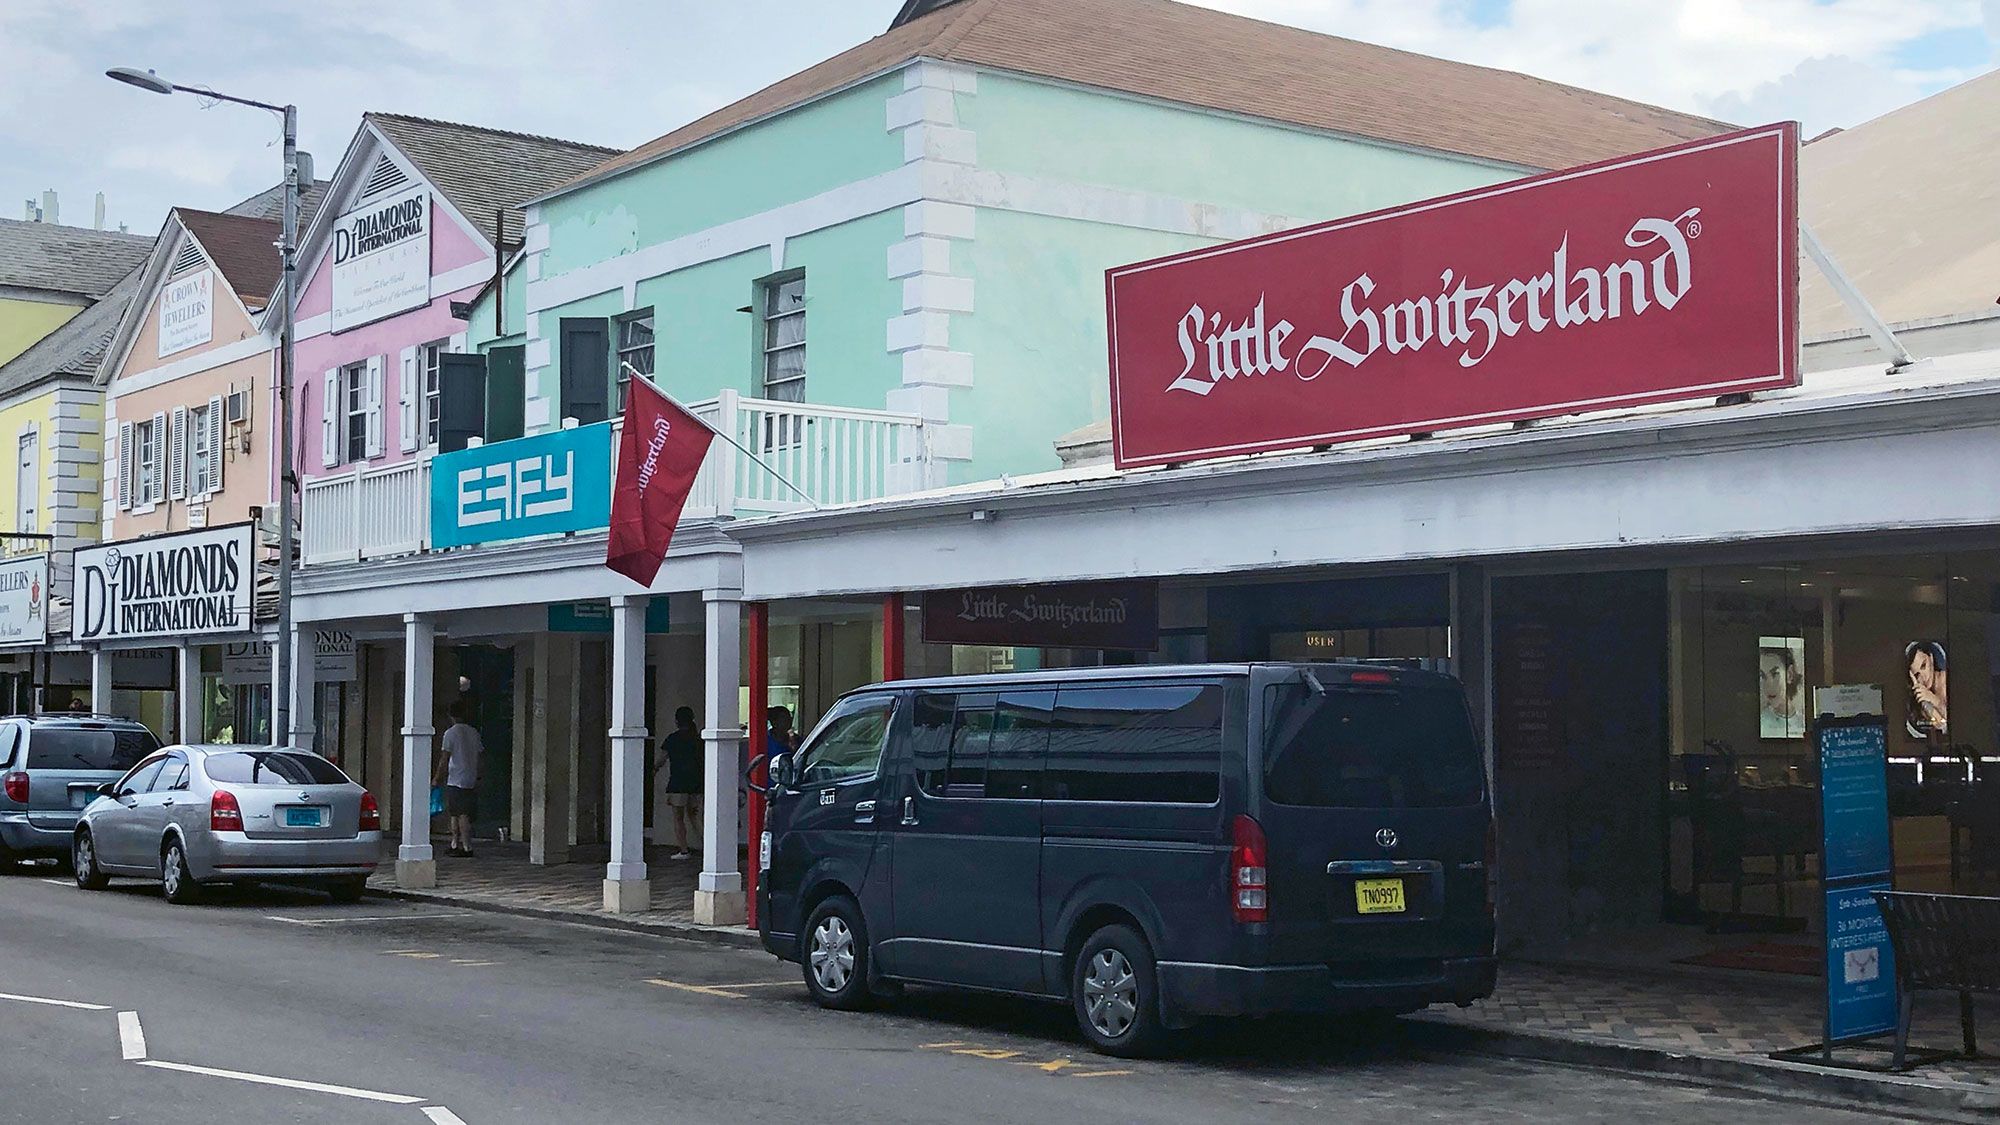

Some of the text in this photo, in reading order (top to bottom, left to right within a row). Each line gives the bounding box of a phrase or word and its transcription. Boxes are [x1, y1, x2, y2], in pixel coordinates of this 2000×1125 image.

[357, 195, 423, 240] DIAMONDS
[357, 219, 423, 255] INTERNATIONAL
[171, 281, 198, 303] CROWN
[1165, 206, 1702, 396] Little Switzerland
[163, 300, 206, 329] JEWELLERS
[638, 413, 671, 499] witzerland
[120, 539, 239, 601] DIAMONDS
[120, 594, 239, 634] INTERNATIONAL
[957, 590, 1128, 629] Little Switzerland
